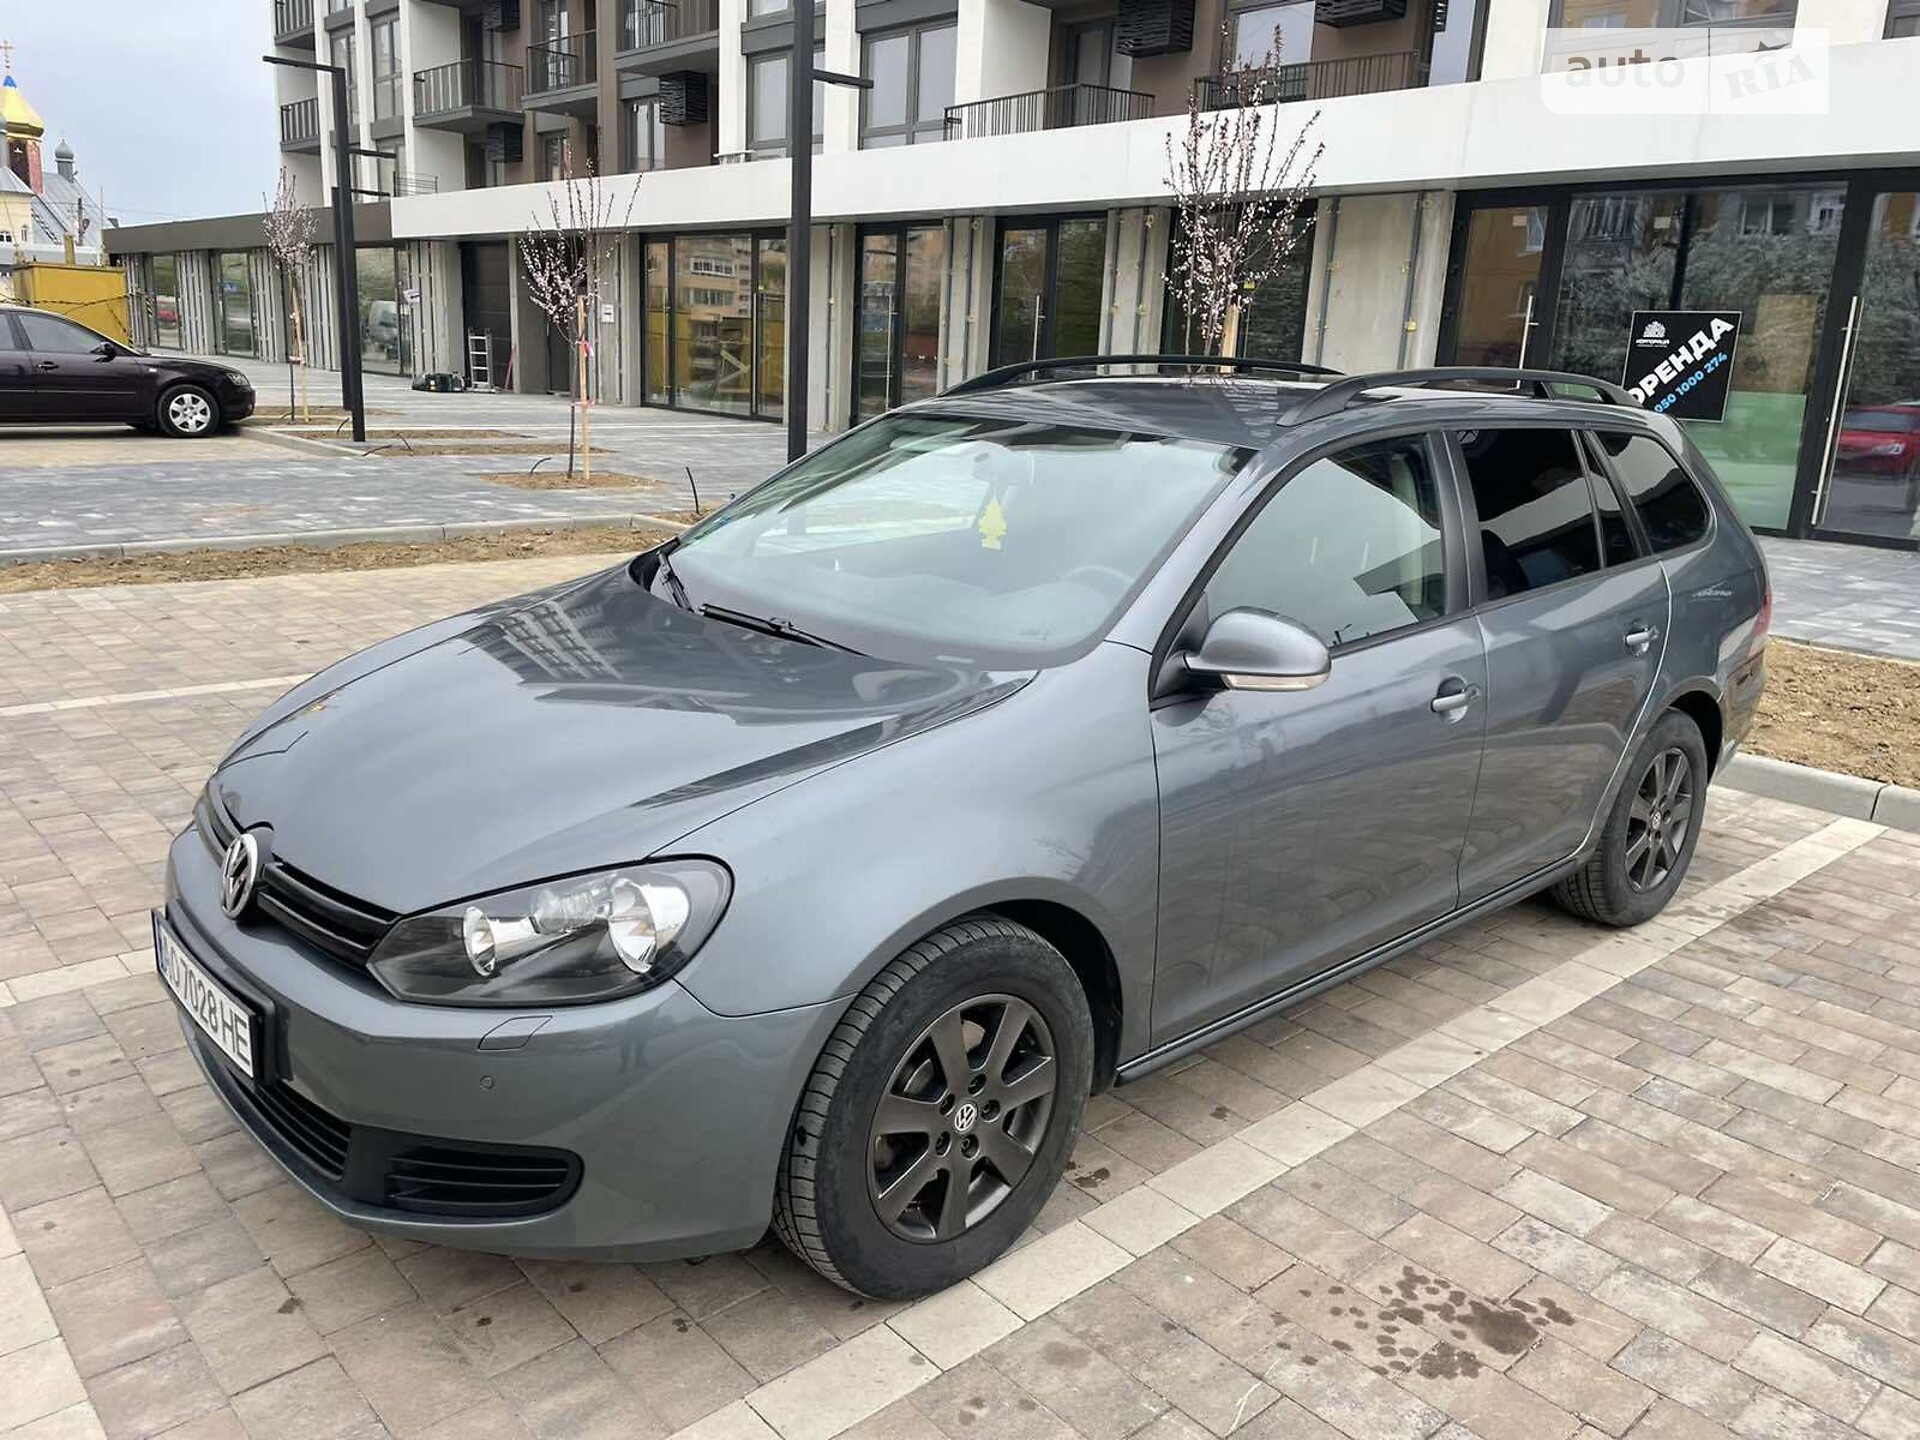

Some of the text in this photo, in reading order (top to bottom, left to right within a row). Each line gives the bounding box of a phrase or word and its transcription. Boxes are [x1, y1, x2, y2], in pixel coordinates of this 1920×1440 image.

[1654, 352, 1728, 413] 050 1000 274
